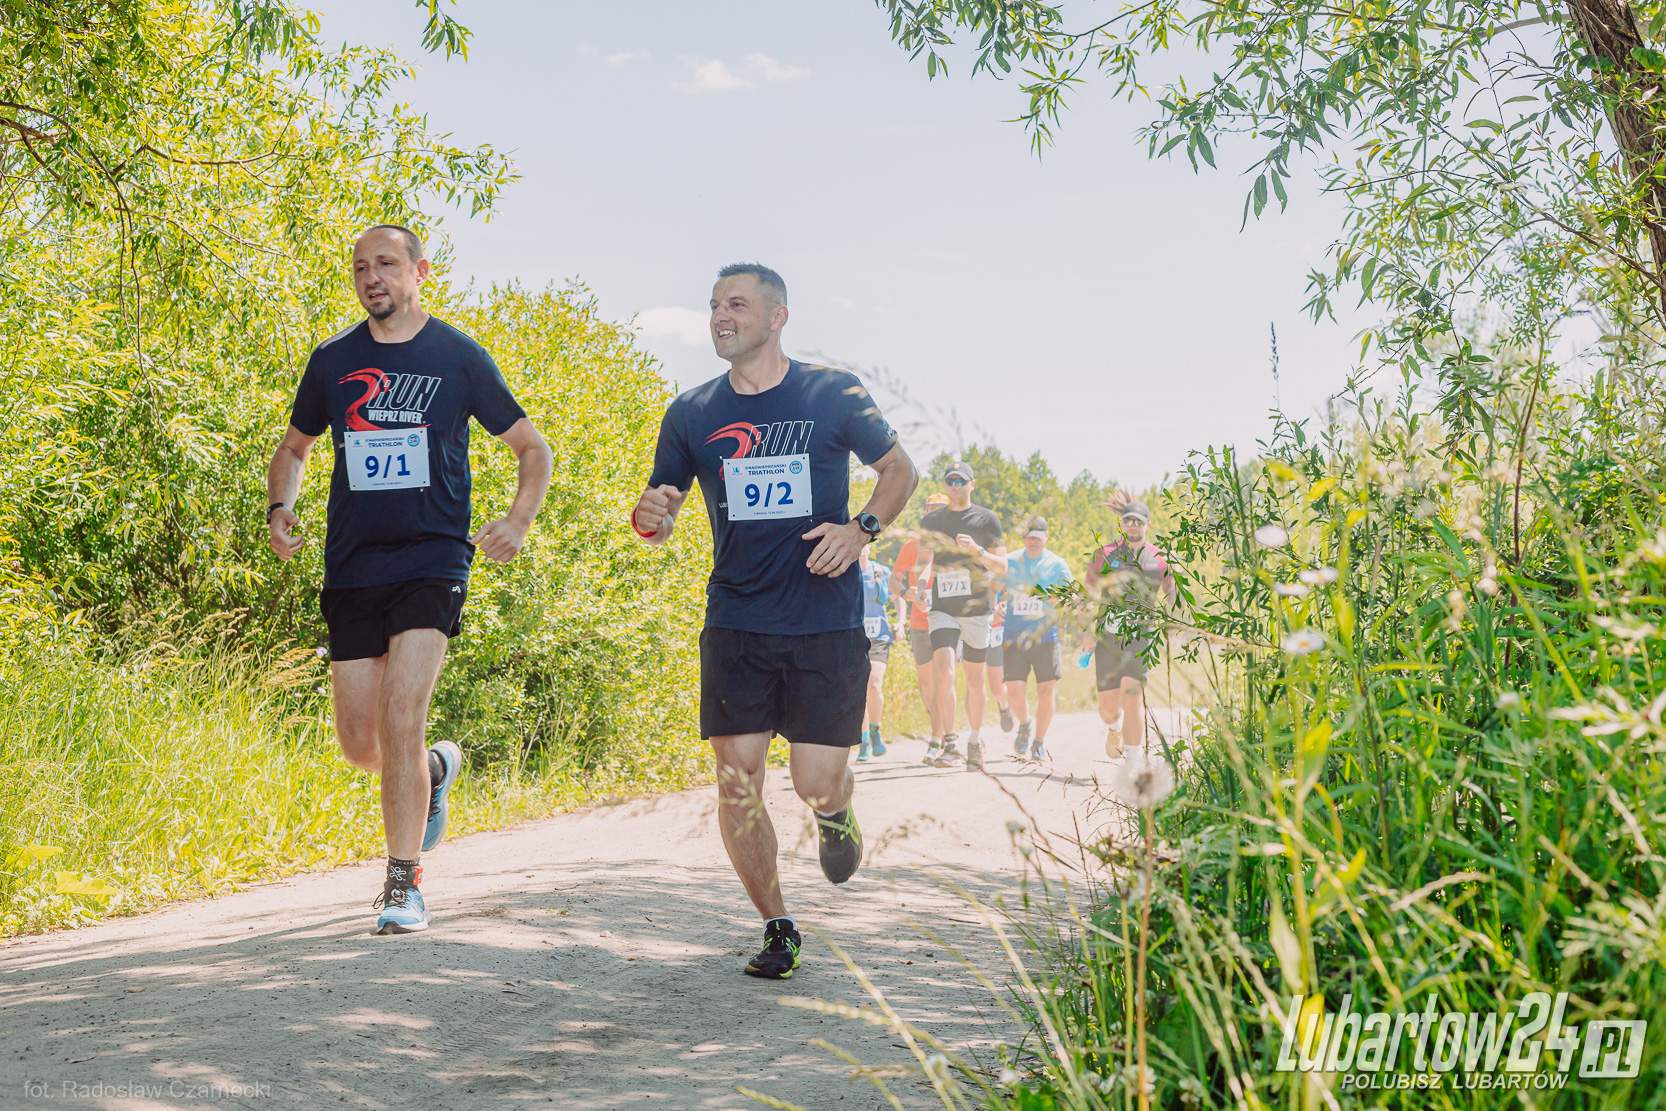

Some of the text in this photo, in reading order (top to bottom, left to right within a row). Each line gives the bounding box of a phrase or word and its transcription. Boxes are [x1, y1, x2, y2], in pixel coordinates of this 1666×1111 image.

[366, 373, 442, 412] RUN
[368, 410, 423, 424] WIEPRZ RIVER
[743, 421, 814, 458] RUN
[365, 453, 410, 478] 9/1
[748, 468, 785, 476] TRIATHLON
[744, 481, 794, 508] 9/2
[942, 580, 966, 593] 17/1
